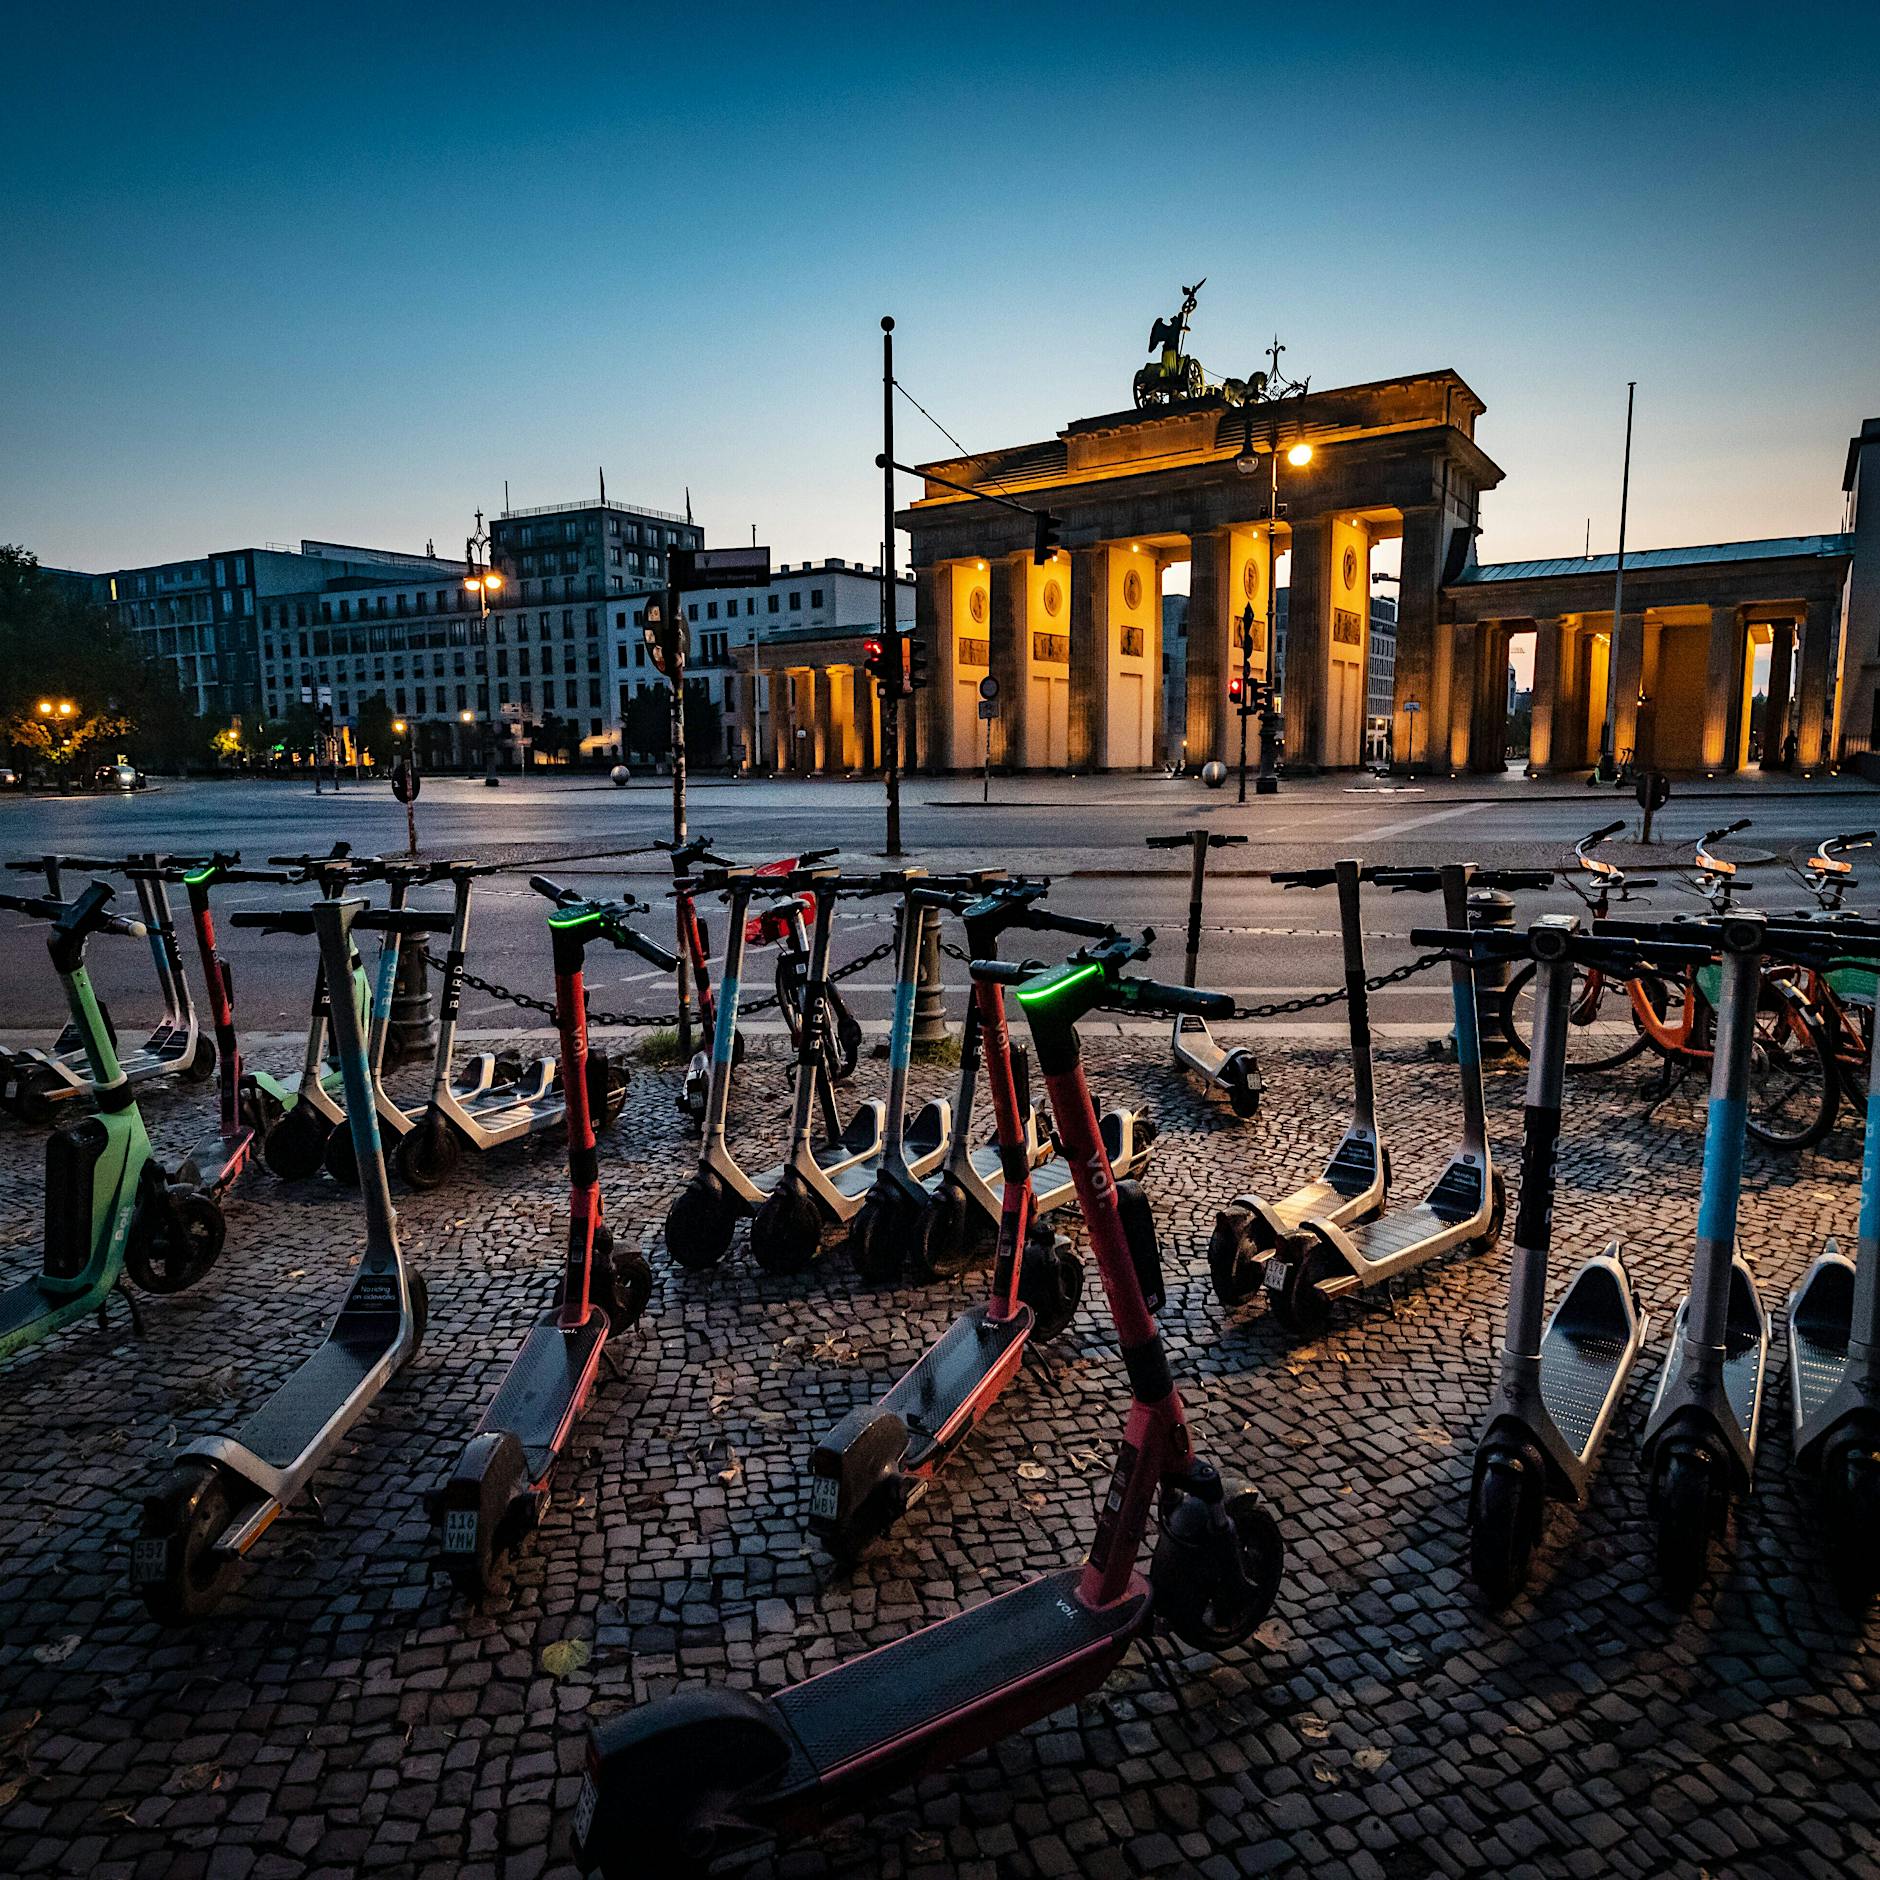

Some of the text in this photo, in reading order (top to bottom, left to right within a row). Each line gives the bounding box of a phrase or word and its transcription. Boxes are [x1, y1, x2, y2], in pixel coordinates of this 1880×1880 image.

[449, 965, 463, 1008] BIRD
[809, 996, 825, 1050] BIRD
[1086, 1149, 1117, 1209] voi.
[816, 1478, 837, 1496] 738
[449, 1514, 474, 1530] 116
[136, 1542, 164, 1559] 557
[1056, 1599, 1078, 1619] voi.
